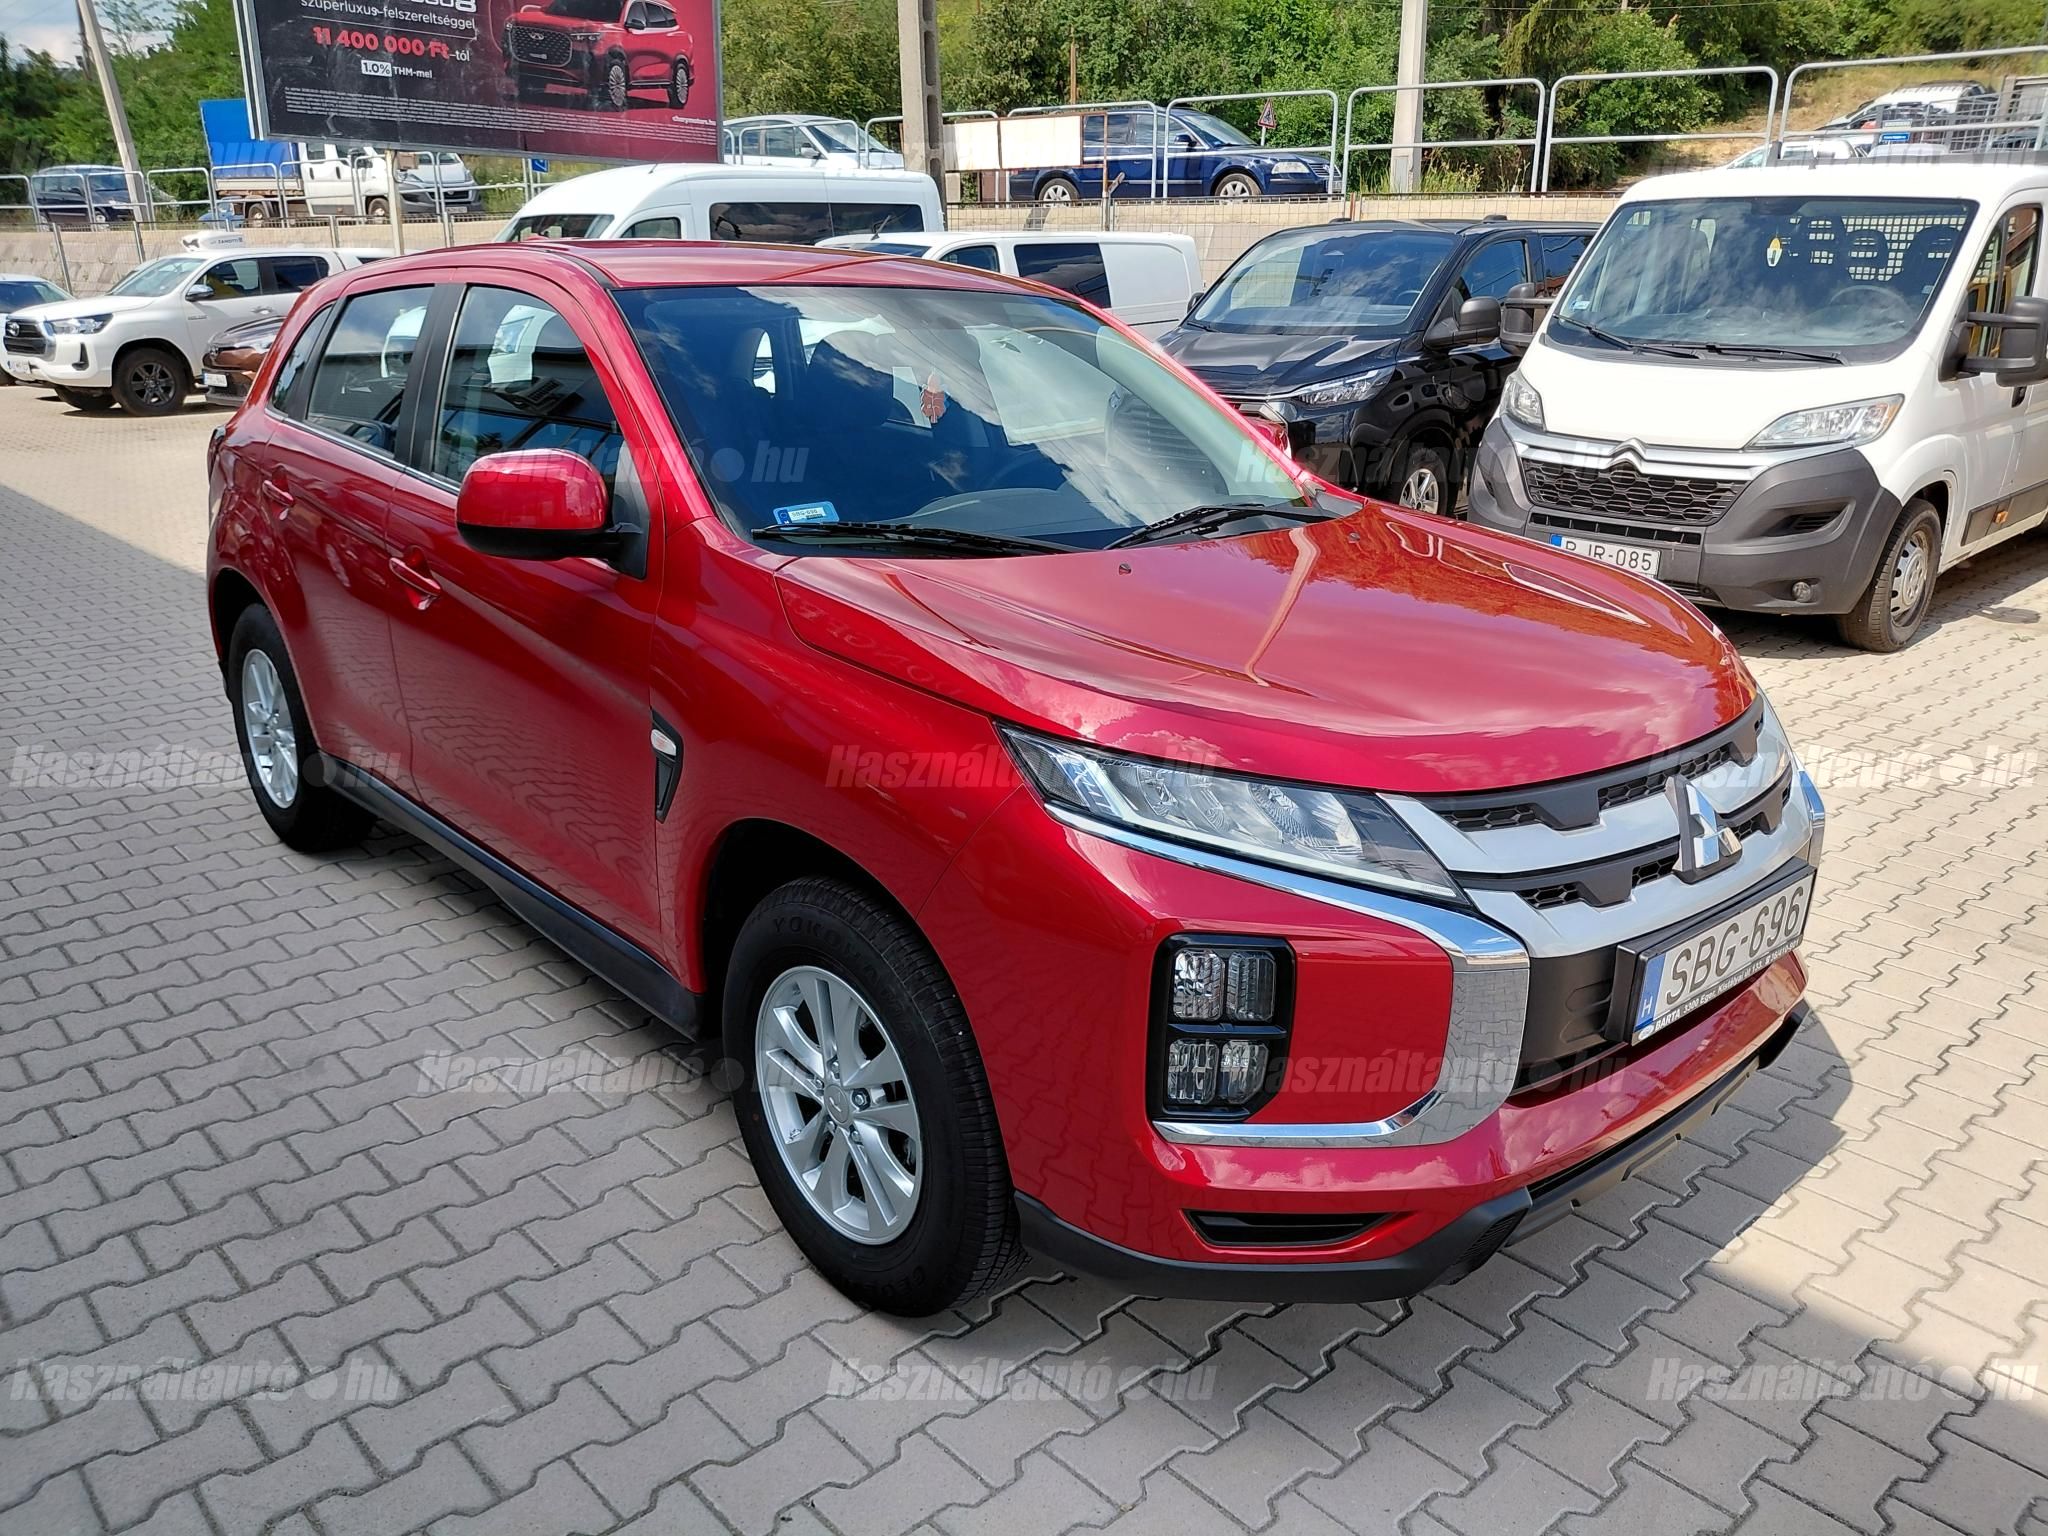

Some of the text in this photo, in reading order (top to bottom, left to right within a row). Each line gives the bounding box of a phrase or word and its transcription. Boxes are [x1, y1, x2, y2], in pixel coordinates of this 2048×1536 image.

[336, 29, 379, 51] 400
[383, 35, 425, 57] 000
[1666, 886, 1804, 1006] SBG-696
[1653, 1009, 1681, 1032] BARTA
